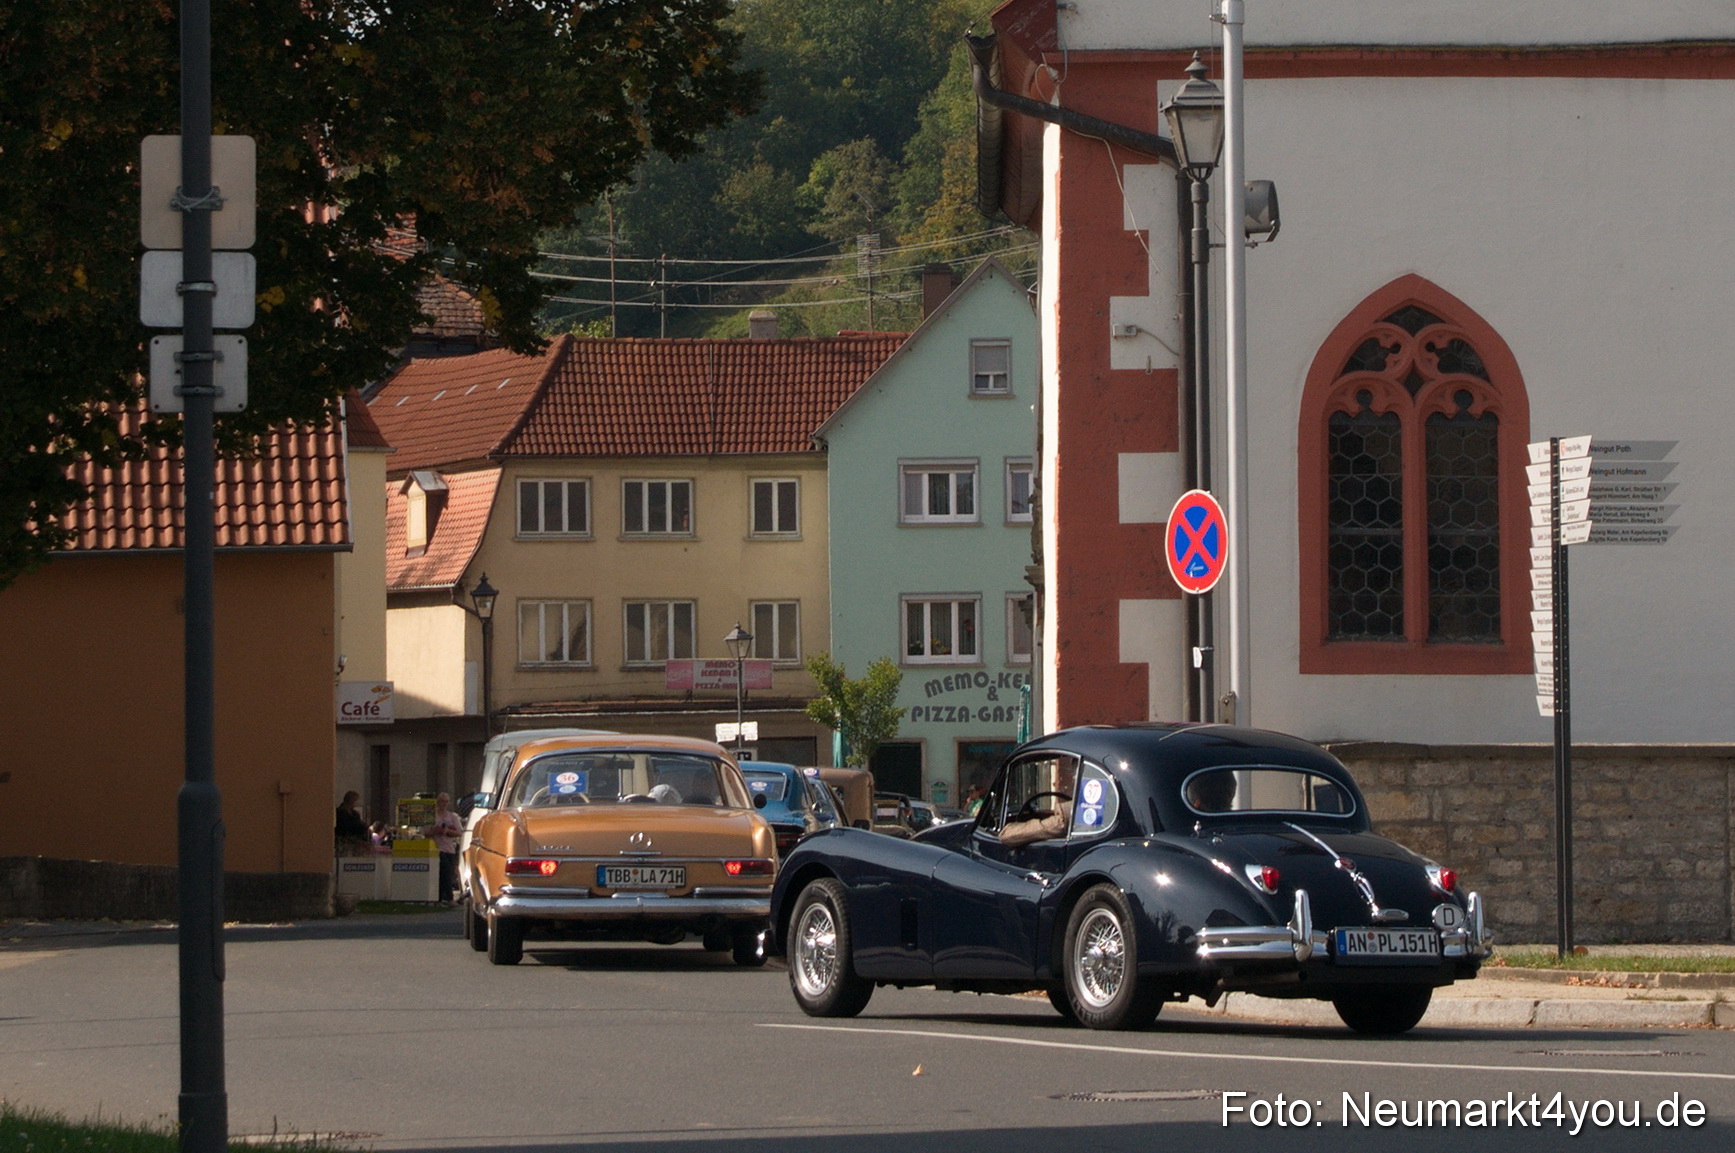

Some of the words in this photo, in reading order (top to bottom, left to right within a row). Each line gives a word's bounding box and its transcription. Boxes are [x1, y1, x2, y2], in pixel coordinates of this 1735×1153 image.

[987, 686, 999, 701] &
[341, 700, 380, 716] Café
[607, 869, 631, 883] TBB
[640, 869, 657, 883] LA
[660, 869, 684, 884] 71H
[1443, 907, 1454, 926] D
[1349, 934, 1367, 952] AN
[1380, 934, 1397, 952] PL
[1399, 934, 1438, 953] 151H
